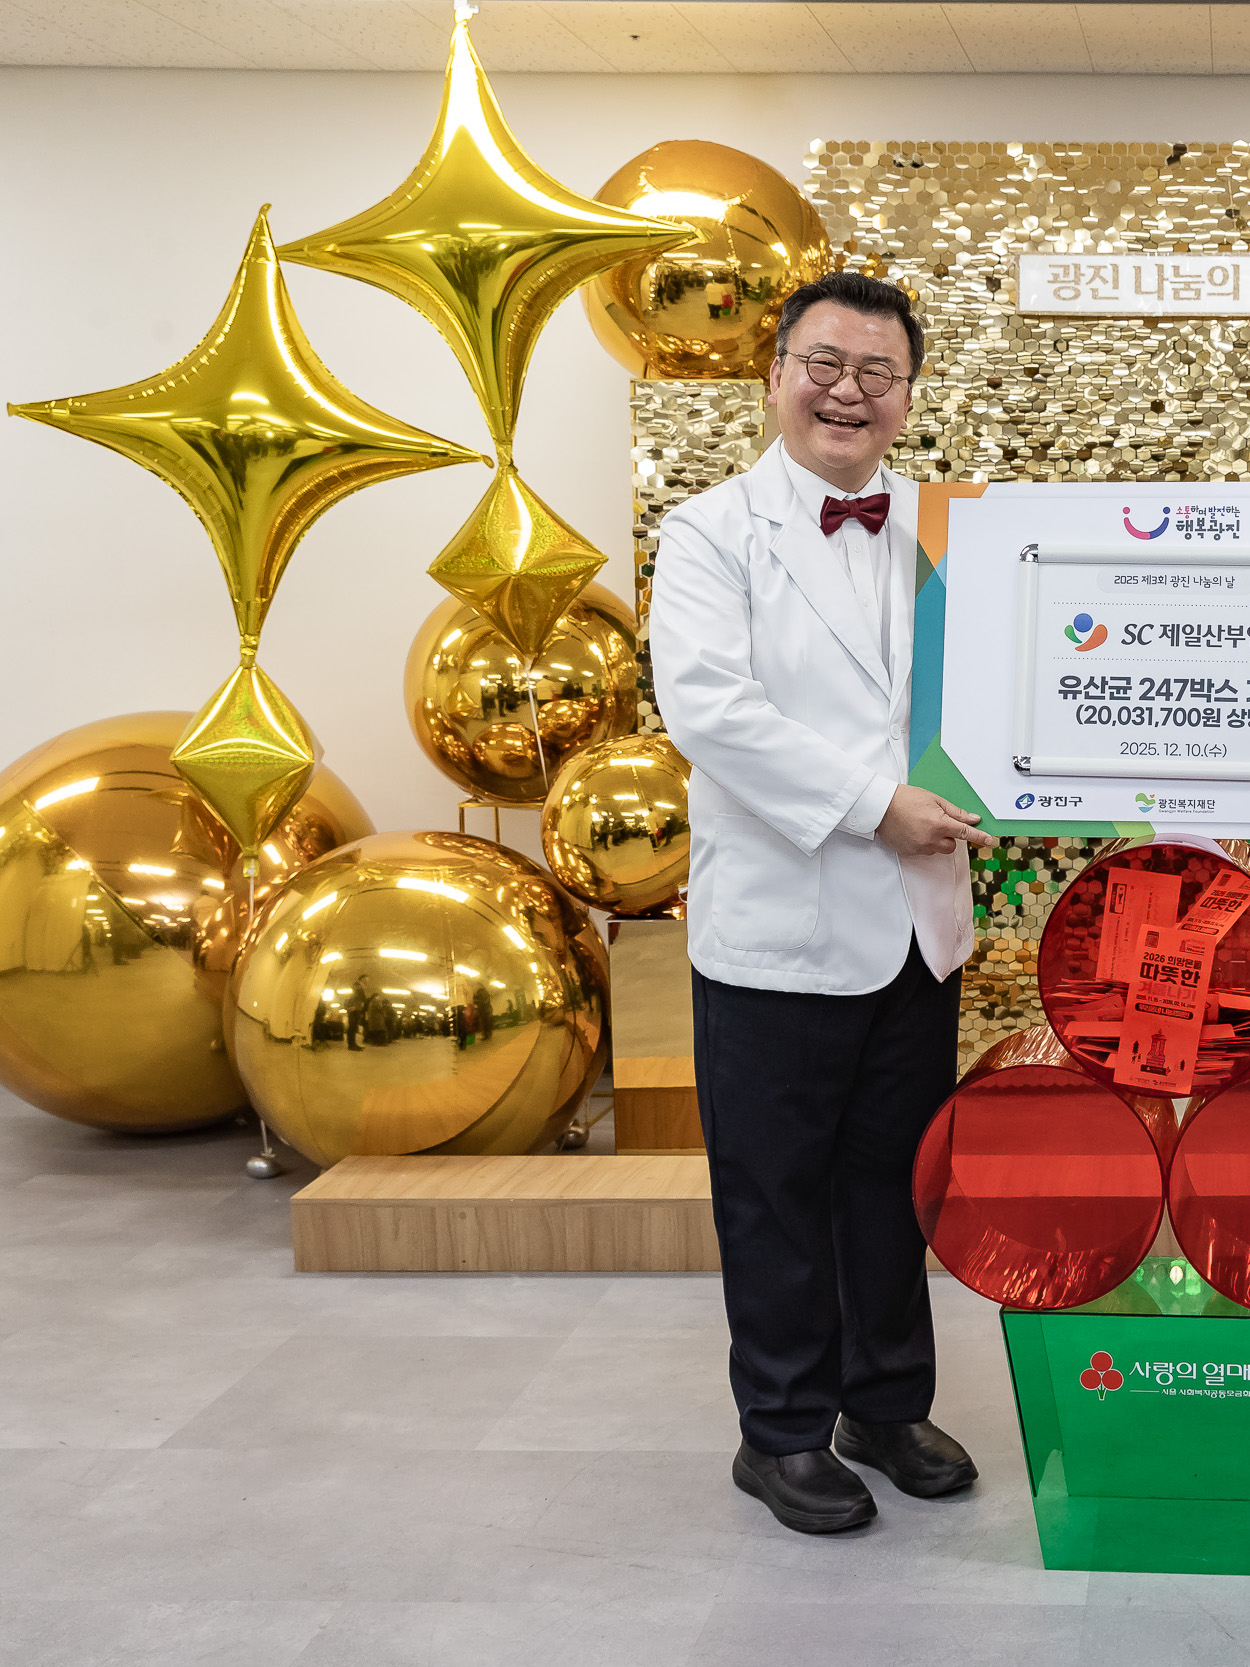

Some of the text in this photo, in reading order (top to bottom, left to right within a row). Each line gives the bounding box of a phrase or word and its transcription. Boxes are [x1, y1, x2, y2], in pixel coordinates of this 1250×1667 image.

[1046, 262, 1120, 302] 광진
[1132, 263, 1241, 302] 나눔의
[1176, 505, 1241, 519] 소통하며 발전하는
[1175, 518, 1240, 541] 행복광진
[1113, 574, 1236, 589] 2025 제3회 광진 나눔의 날
[1120, 623, 1155, 646] SC
[1058, 675, 1133, 700] 유산균
[1139, 677, 1239, 703] 247박스
[1075, 706, 1221, 728] (20,031,700원
[1119, 741, 1228, 758] 2025. 12. 10.(수)
[1037, 795, 1083, 808] 광진구
[1158, 798, 1216, 810] 광진복지재단
[1200, 896, 1243, 913] 따뜻한
[1143, 952, 1166, 963] 2026
[1139, 962, 1201, 988] 따뜻한
[1128, 1361, 1197, 1386] 사랑의
[1178, 1388, 1250, 1399] 사회복지공동모금회
